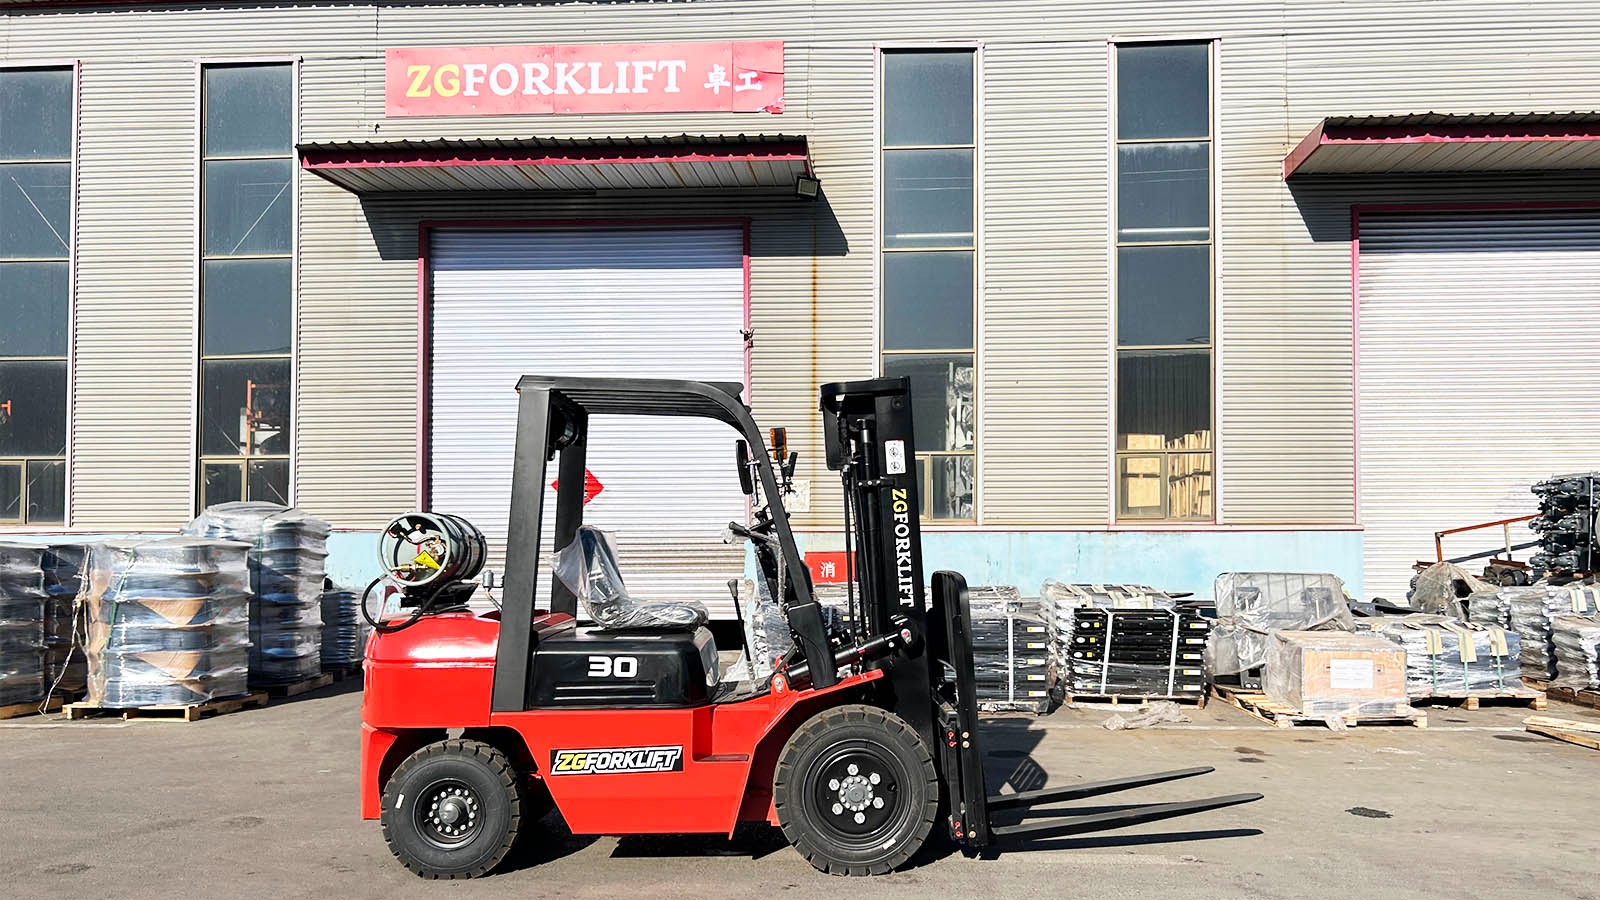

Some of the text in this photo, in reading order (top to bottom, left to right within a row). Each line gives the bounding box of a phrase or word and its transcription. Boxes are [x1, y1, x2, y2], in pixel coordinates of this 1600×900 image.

[406, 60, 687, 97] ZGFORKLIFT
[703, 63, 762, 95] 卓工
[892, 488, 915, 608] ZGFORKLIFT
[820, 561, 836, 578] 消
[587, 655, 638, 678] 30
[556, 749, 678, 771] ZGFORKLIFT
